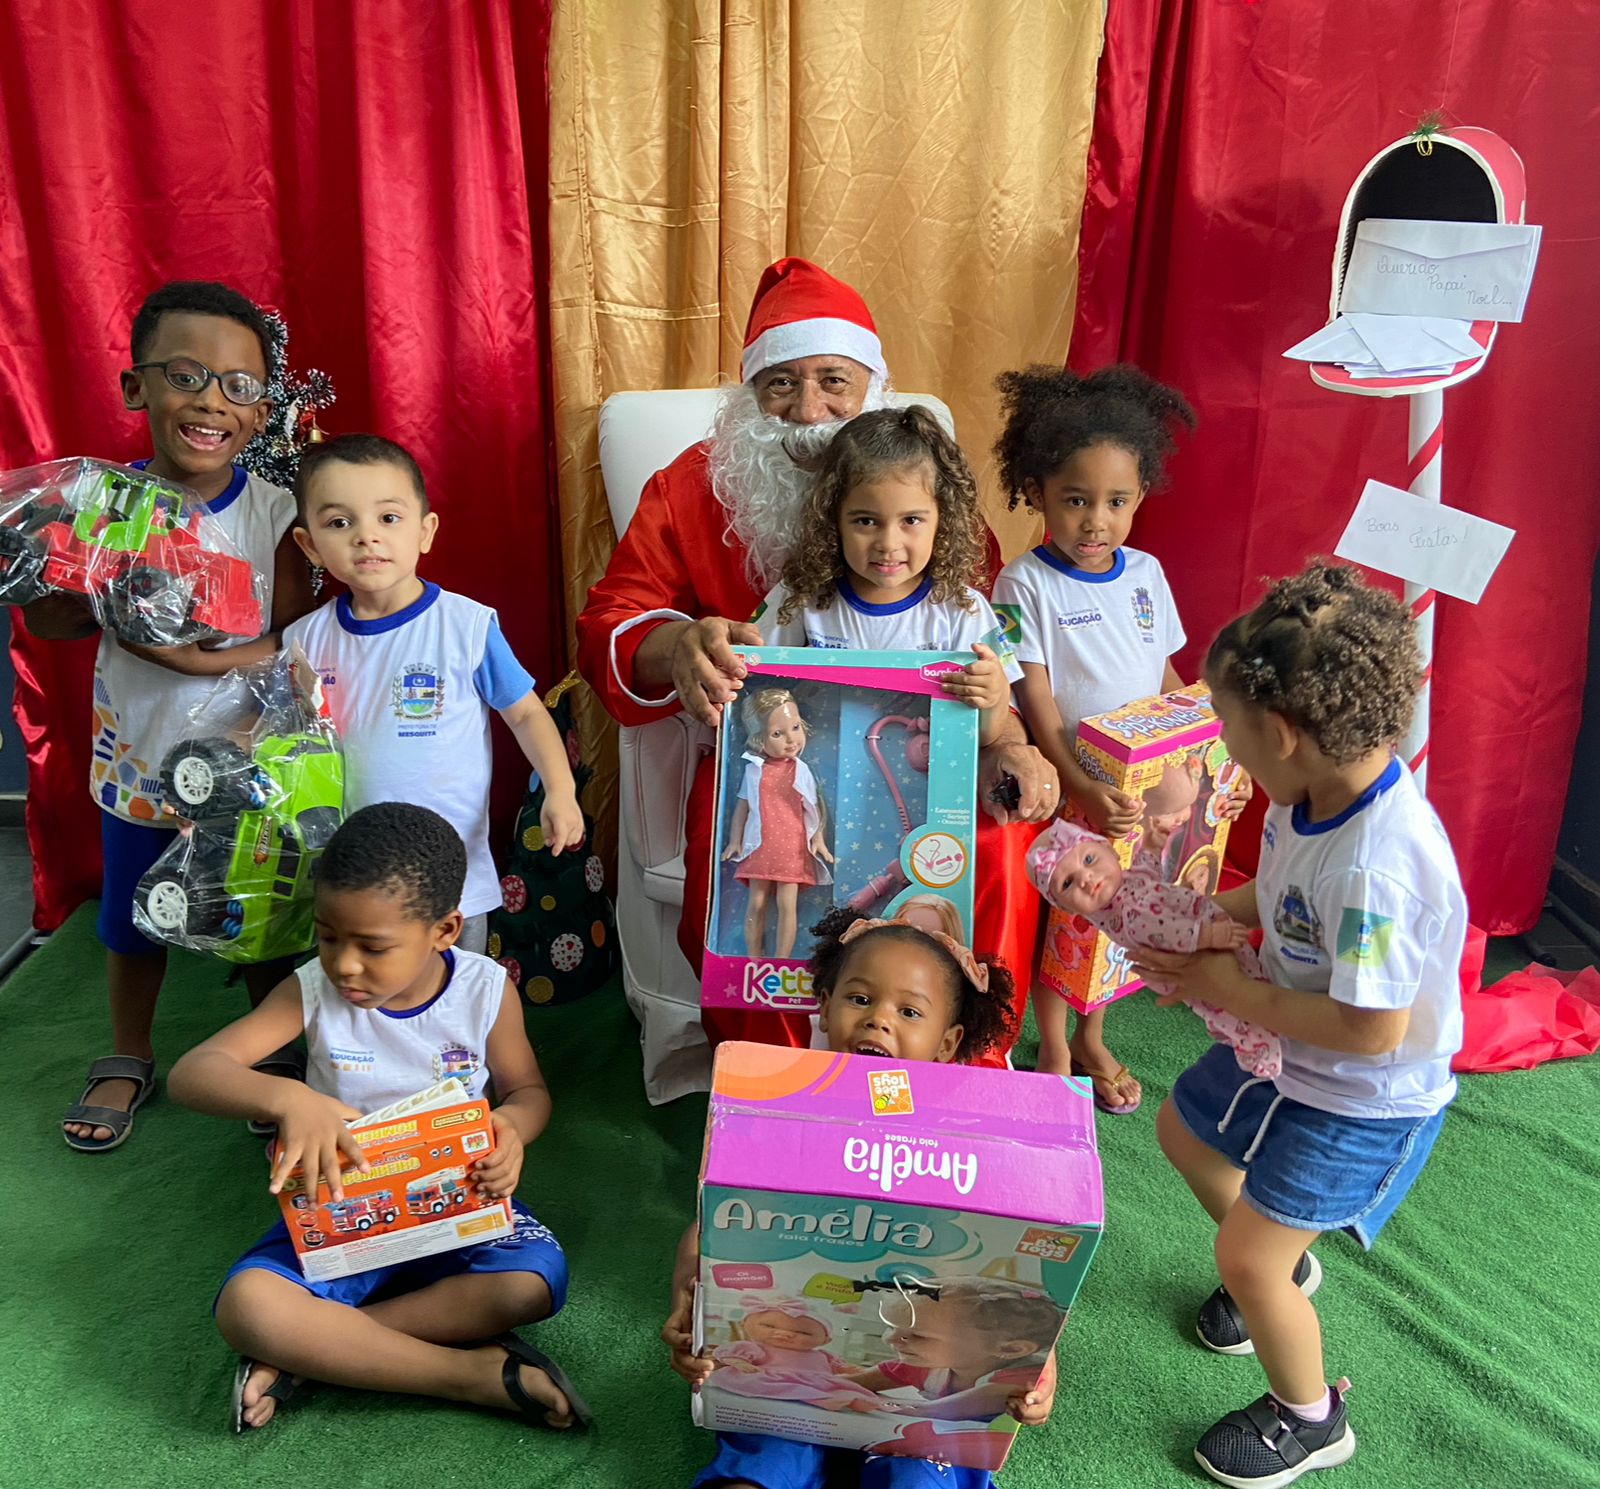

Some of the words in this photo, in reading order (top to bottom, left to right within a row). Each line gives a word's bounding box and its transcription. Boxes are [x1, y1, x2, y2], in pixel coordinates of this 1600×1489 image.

[1377, 255, 1438, 275] Querido
[1428, 275, 1467, 295] Papai
[1365, 517, 1399, 533] Boas
[397, 730, 437, 738] MESQUITA
[743, 963, 814, 1003] Kett
[329, 1052, 375, 1063] EDUCAÇÃO
[872, 1073, 908, 1090] Toys
[874, 1085, 899, 1097] Bee
[884, 1133, 917, 1146] frases
[918, 1137, 939, 1148] fala
[843, 1136, 978, 1195] Amélia
[713, 1198, 935, 1250] Amélia
[778, 1233, 809, 1242] fala
[814, 1236, 865, 1248] frases
[1019, 1240, 1067, 1258] Toys
